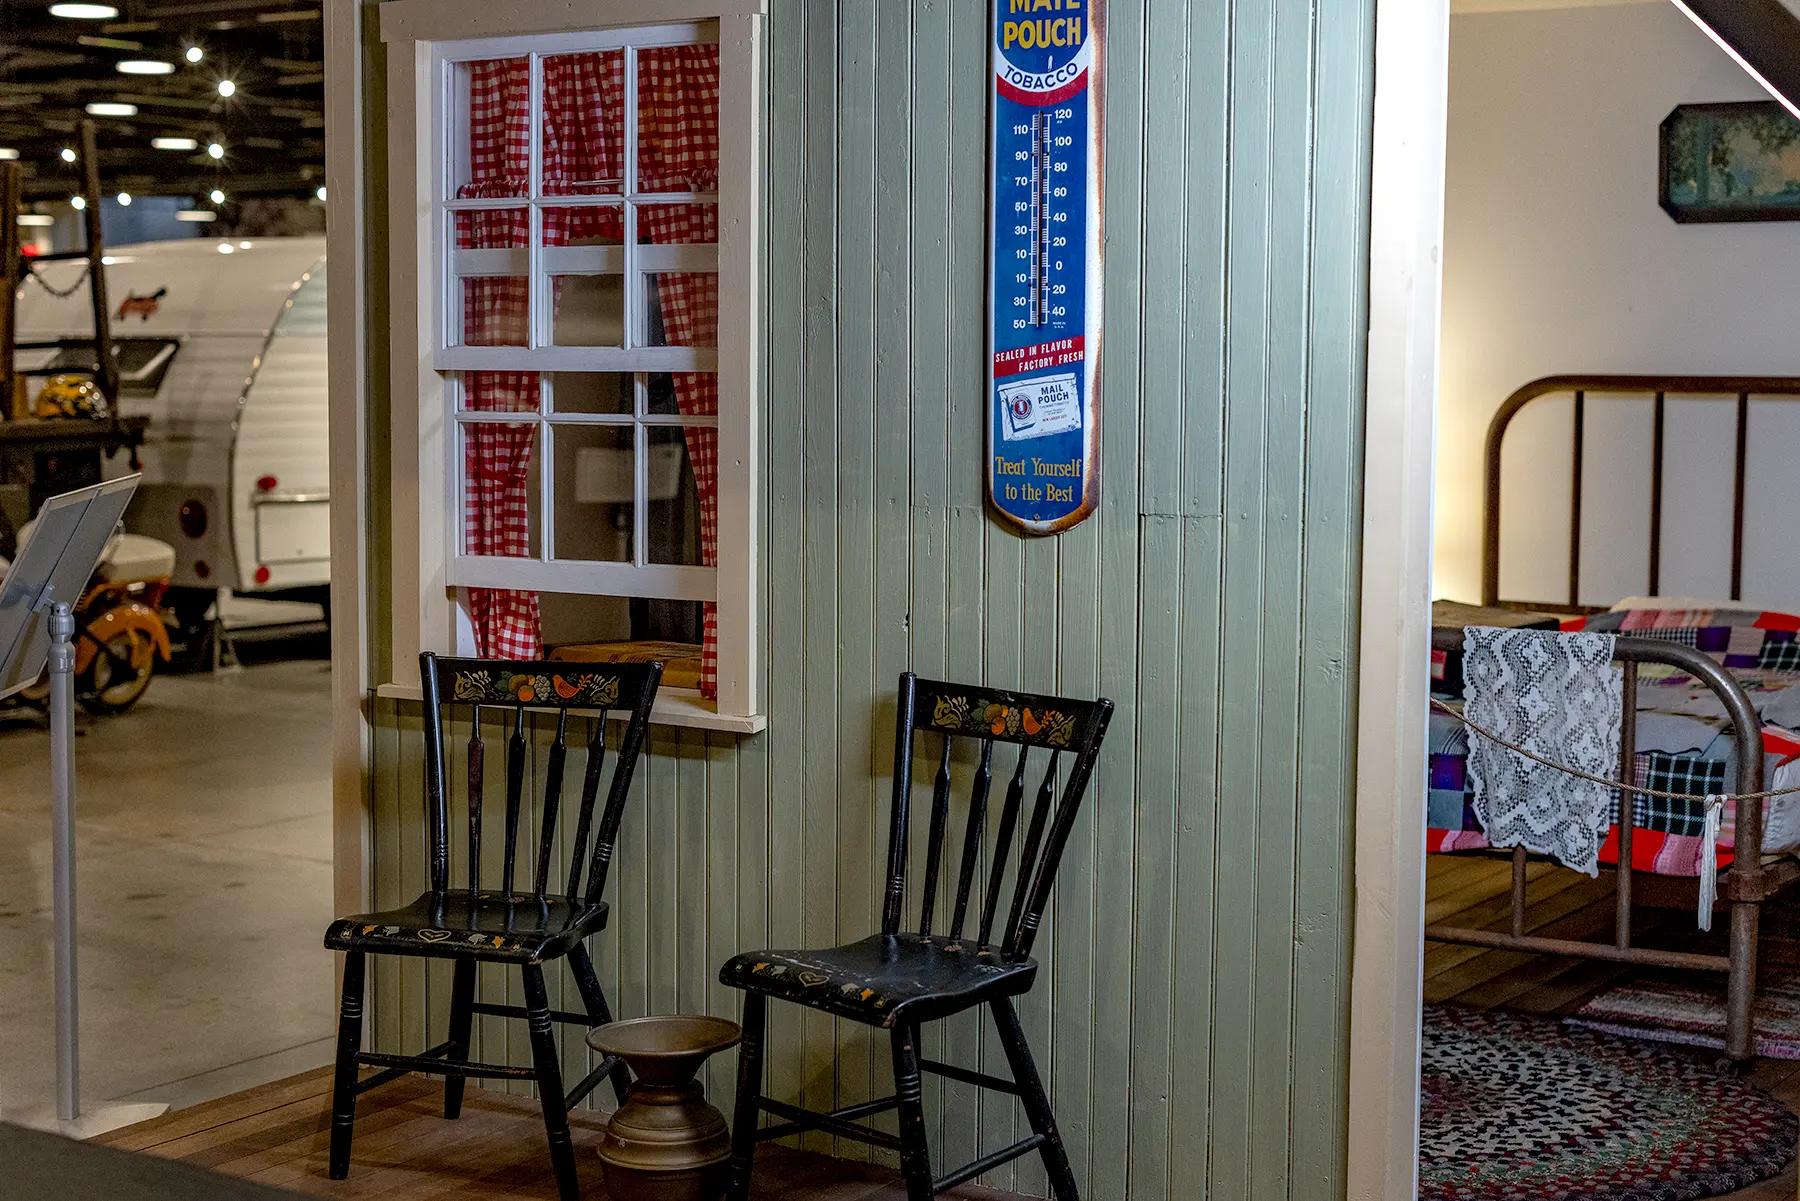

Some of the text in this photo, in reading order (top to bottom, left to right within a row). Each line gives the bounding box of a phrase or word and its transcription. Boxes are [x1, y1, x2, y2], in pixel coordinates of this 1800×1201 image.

[1003, 17, 1081, 50] POUCH
[1004, 62, 1078, 90] TOBACCO
[1054, 109, 1072, 119] 120
[1013, 124, 1029, 135] 110
[1054, 136, 1072, 146] 100
[1015, 151, 1028, 161] 90
[1054, 162, 1068, 172] 80
[1015, 176, 1028, 186] 70
[1053, 187, 1067, 197] 60
[1014, 202, 1028, 211] 50
[1053, 212, 1067, 222] 40
[1014, 225, 1027, 235] 30
[1053, 237, 1066, 247] 20
[1016, 249, 1027, 259] 10
[1055, 261, 1063, 270] 0
[1015, 273, 1027, 283] 10
[1052, 285, 1066, 294] 20
[1013, 297, 1027, 306] 30
[1052, 306, 1065, 316] 40
[1013, 319, 1026, 329] 50
[995, 339, 1073, 363] SEALED IN FLAVOR
[1018, 350, 1084, 372] FACTORY FRESH
[1041, 384, 1064, 395] MAIL
[1038, 391, 1069, 405] POUCH
[995, 456, 1082, 477] Treat Yourself
[1005, 483, 1073, 503] to the Best
